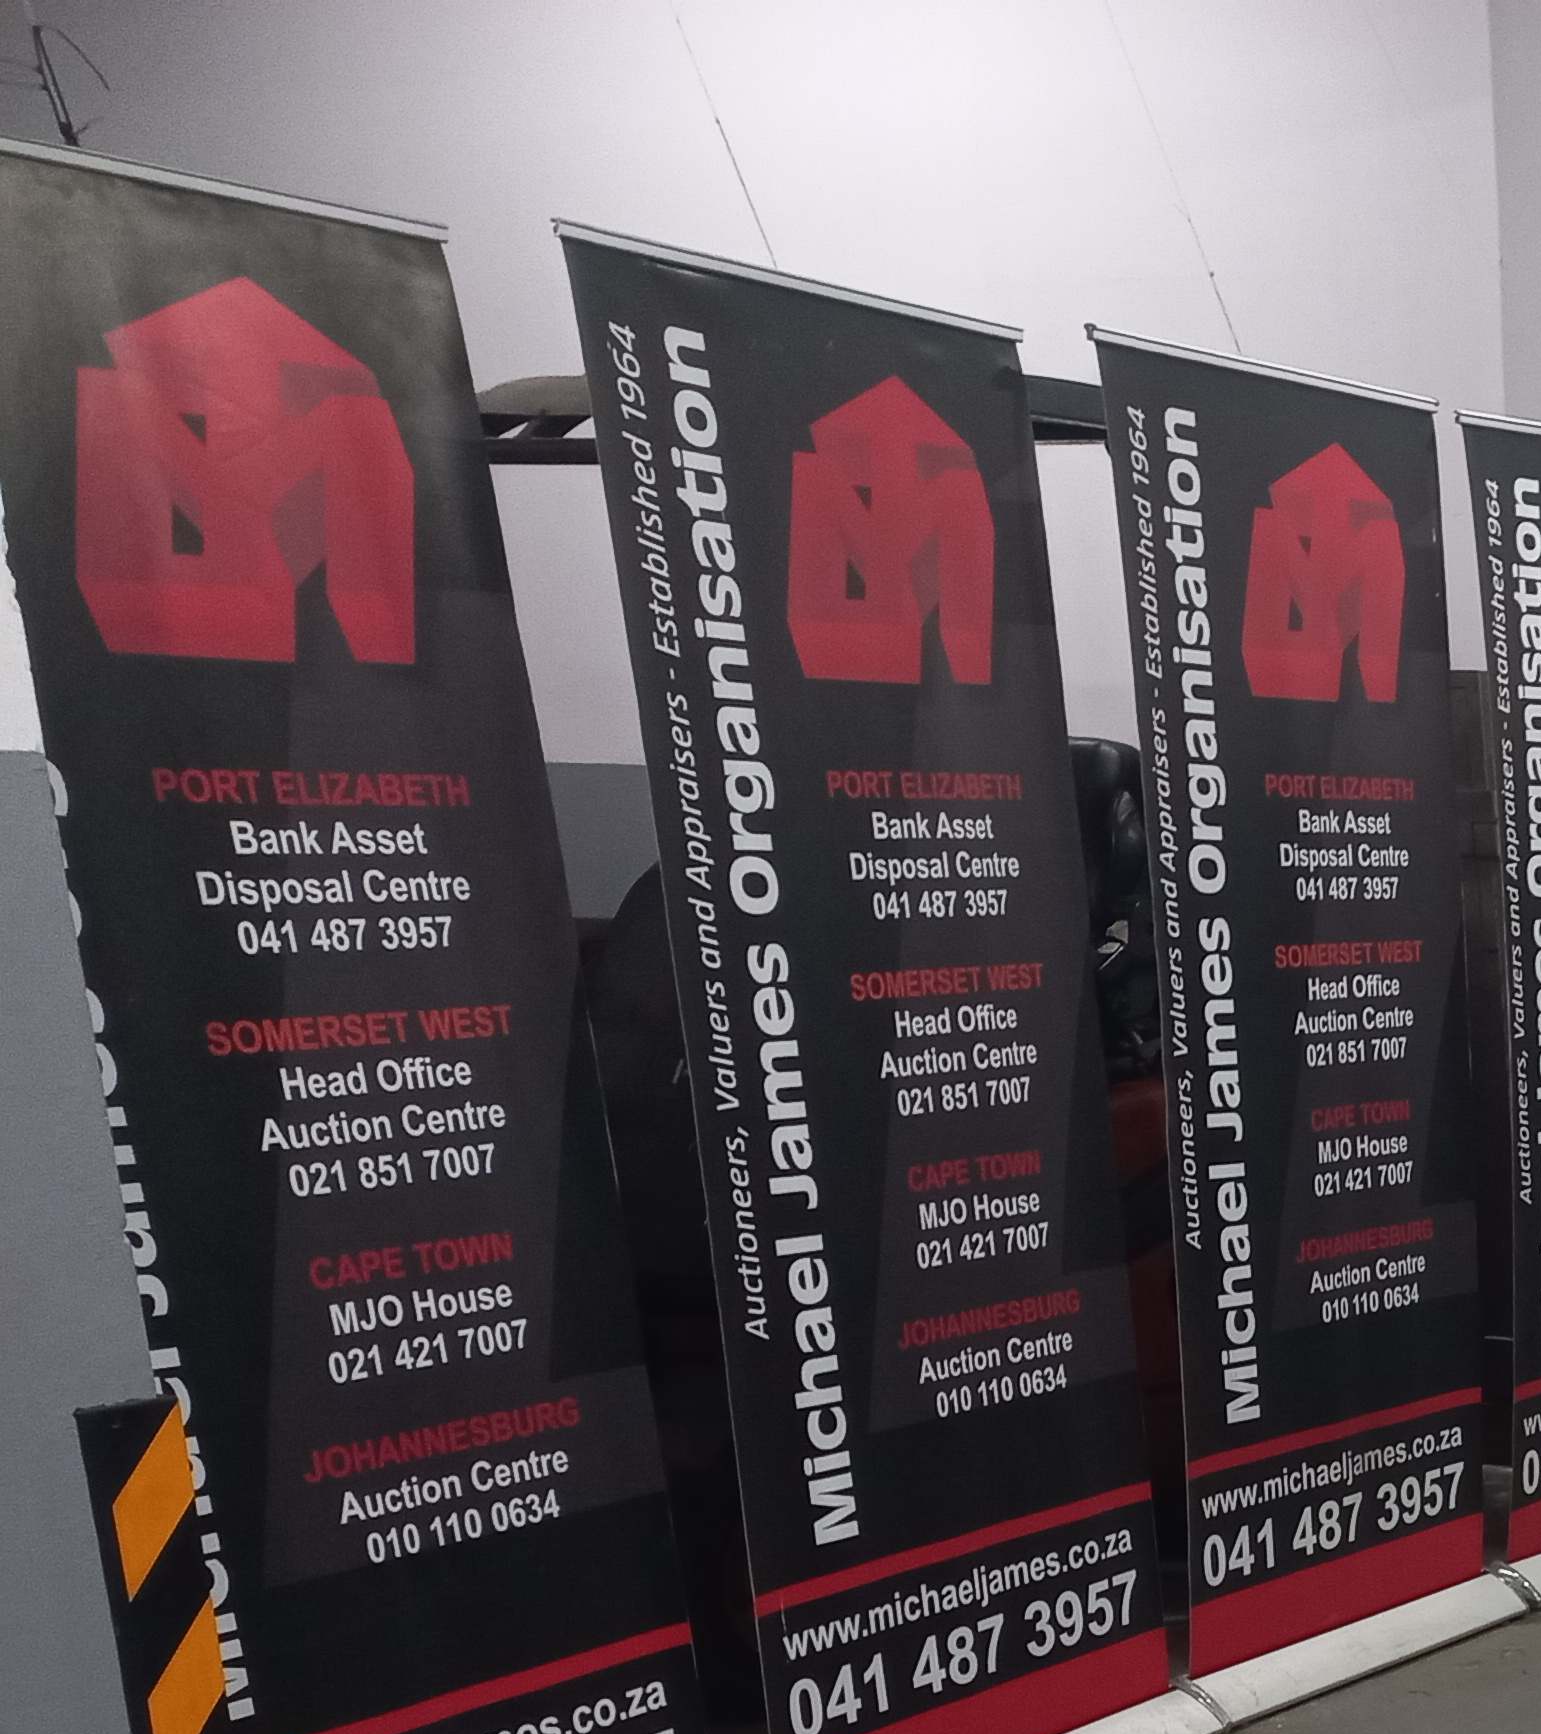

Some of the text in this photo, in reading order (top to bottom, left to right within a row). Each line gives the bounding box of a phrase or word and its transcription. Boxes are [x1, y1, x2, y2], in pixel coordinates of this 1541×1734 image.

[607, 322, 647, 419] 1964
[1127, 406, 1149, 484] 1964
[629, 432, 681, 657] Established
[1132, 494, 1163, 679] Established
[154, 768, 470, 807] PORT ELIZABETH
[667, 692, 714, 890] Appraisers
[826, 769, 1023, 800] PORT ELIZABETH
[1152, 708, 1178, 872] Appraisers
[1264, 773, 1415, 800] PORT ELIZABETH
[230, 821, 427, 854] Bank Asset
[872, 812, 994, 839] Bank Asset
[1299, 809, 1391, 834] Bank Asset
[850, 851, 1019, 885] Disposal Centre
[1280, 843, 1408, 872] Disposal Centre
[196, 870, 470, 912] Disposal Centre
[874, 890, 1007, 919] 041 487 3957
[1161, 878, 1180, 937] and
[1297, 877, 1398, 900] 041 487 3957
[238, 916, 451, 954] 041 487 3957
[663, 325, 859, 1545] Michael James Organisation
[688, 898, 721, 968] and
[1164, 407, 1260, 1423] Michael James Organisation
[1275, 939, 1423, 967] SOMERSET WEST
[851, 963, 1041, 1001] SOMERSET WEST
[1169, 948, 1188, 1056] Valuers
[1308, 975, 1399, 1000] Head Office
[207, 1005, 511, 1055] SOMERSET WEST
[895, 1004, 1017, 1037] Head Office
[1295, 1007, 1413, 1034] Auction Centre
[706, 981, 739, 1110] Valuers
[881, 1042, 1037, 1078] Auction Centre
[1307, 1037, 1406, 1067] 021 851 7007
[280, 1057, 471, 1100] Head Office
[898, 1077, 1029, 1116] 021 851 7007
[262, 1101, 505, 1151] Auction Centre
[1319, 1136, 1407, 1163] MJO House
[290, 1143, 494, 1196] 021 851 7007
[908, 1151, 1041, 1191] CAPE TOWN
[1315, 1161, 1412, 1196] 021 421 7007
[919, 1193, 1039, 1230] MJO House
[310, 1233, 513, 1289] CAPE TOWN
[917, 1222, 1048, 1268] 021 421 7007
[1311, 1255, 1425, 1293] Auction Centre
[329, 1285, 512, 1335] MJO House
[900, 1288, 1081, 1349] JOHANNESBURG
[1323, 1283, 1419, 1322] 010 110 0634
[329, 1319, 526, 1383] 021 421 7007
[920, 1332, 1072, 1384] Auction Centre
[937, 1364, 1066, 1417] 010 110 0634
[304, 1397, 580, 1482] JOHANNESBURG
[341, 1451, 568, 1528] Auction Centre
[1202, 1426, 1462, 1519] www.michaeljames.co.za
[367, 1489, 560, 1563] 010 110 0634
[1204, 1462, 1464, 1586] 041 487 3957
[782, 1527, 1132, 1661] www.michaeljames.co.za
[913, 1613, 1003, 1693] 487
[1025, 1569, 1136, 1656] 3957
